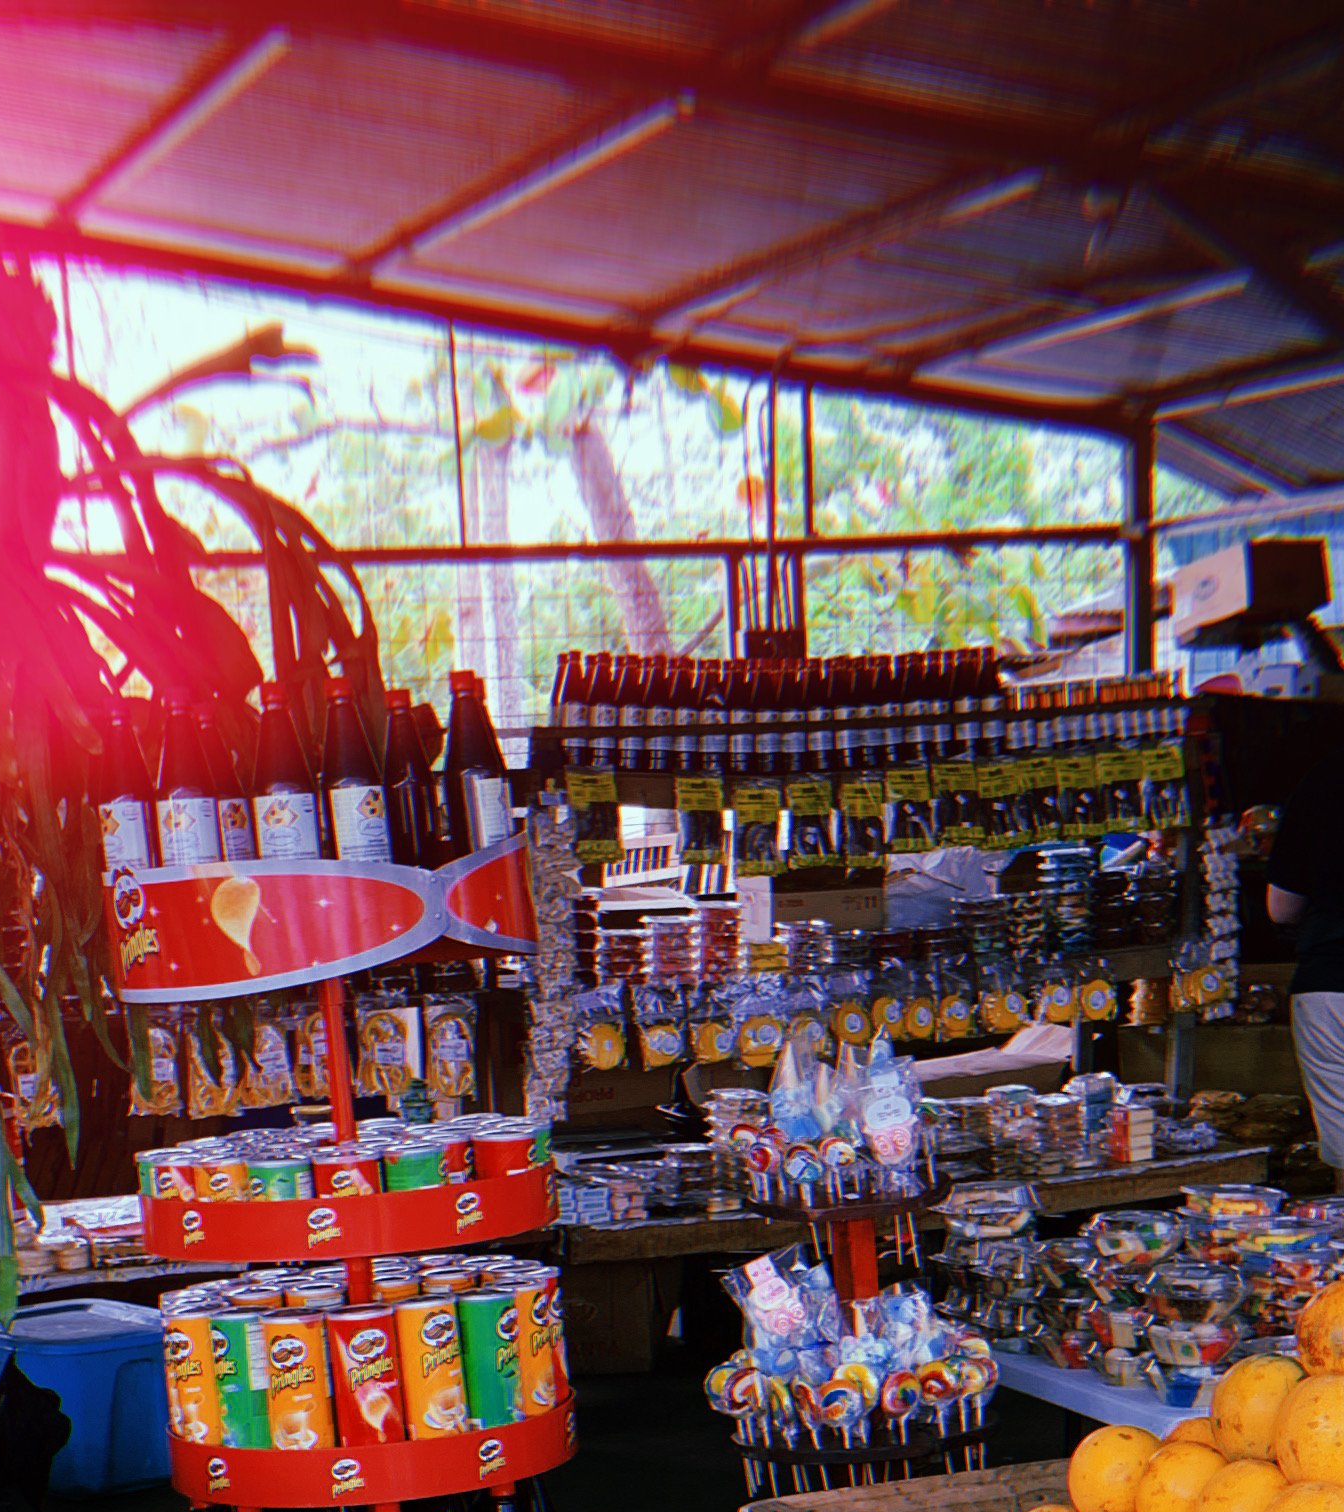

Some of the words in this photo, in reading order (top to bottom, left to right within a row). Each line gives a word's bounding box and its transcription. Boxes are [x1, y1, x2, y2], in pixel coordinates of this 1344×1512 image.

[120, 921, 160, 981] Pringles
[271, 1364, 315, 1399] Pringles
[348, 1354, 394, 1391] Pringles
